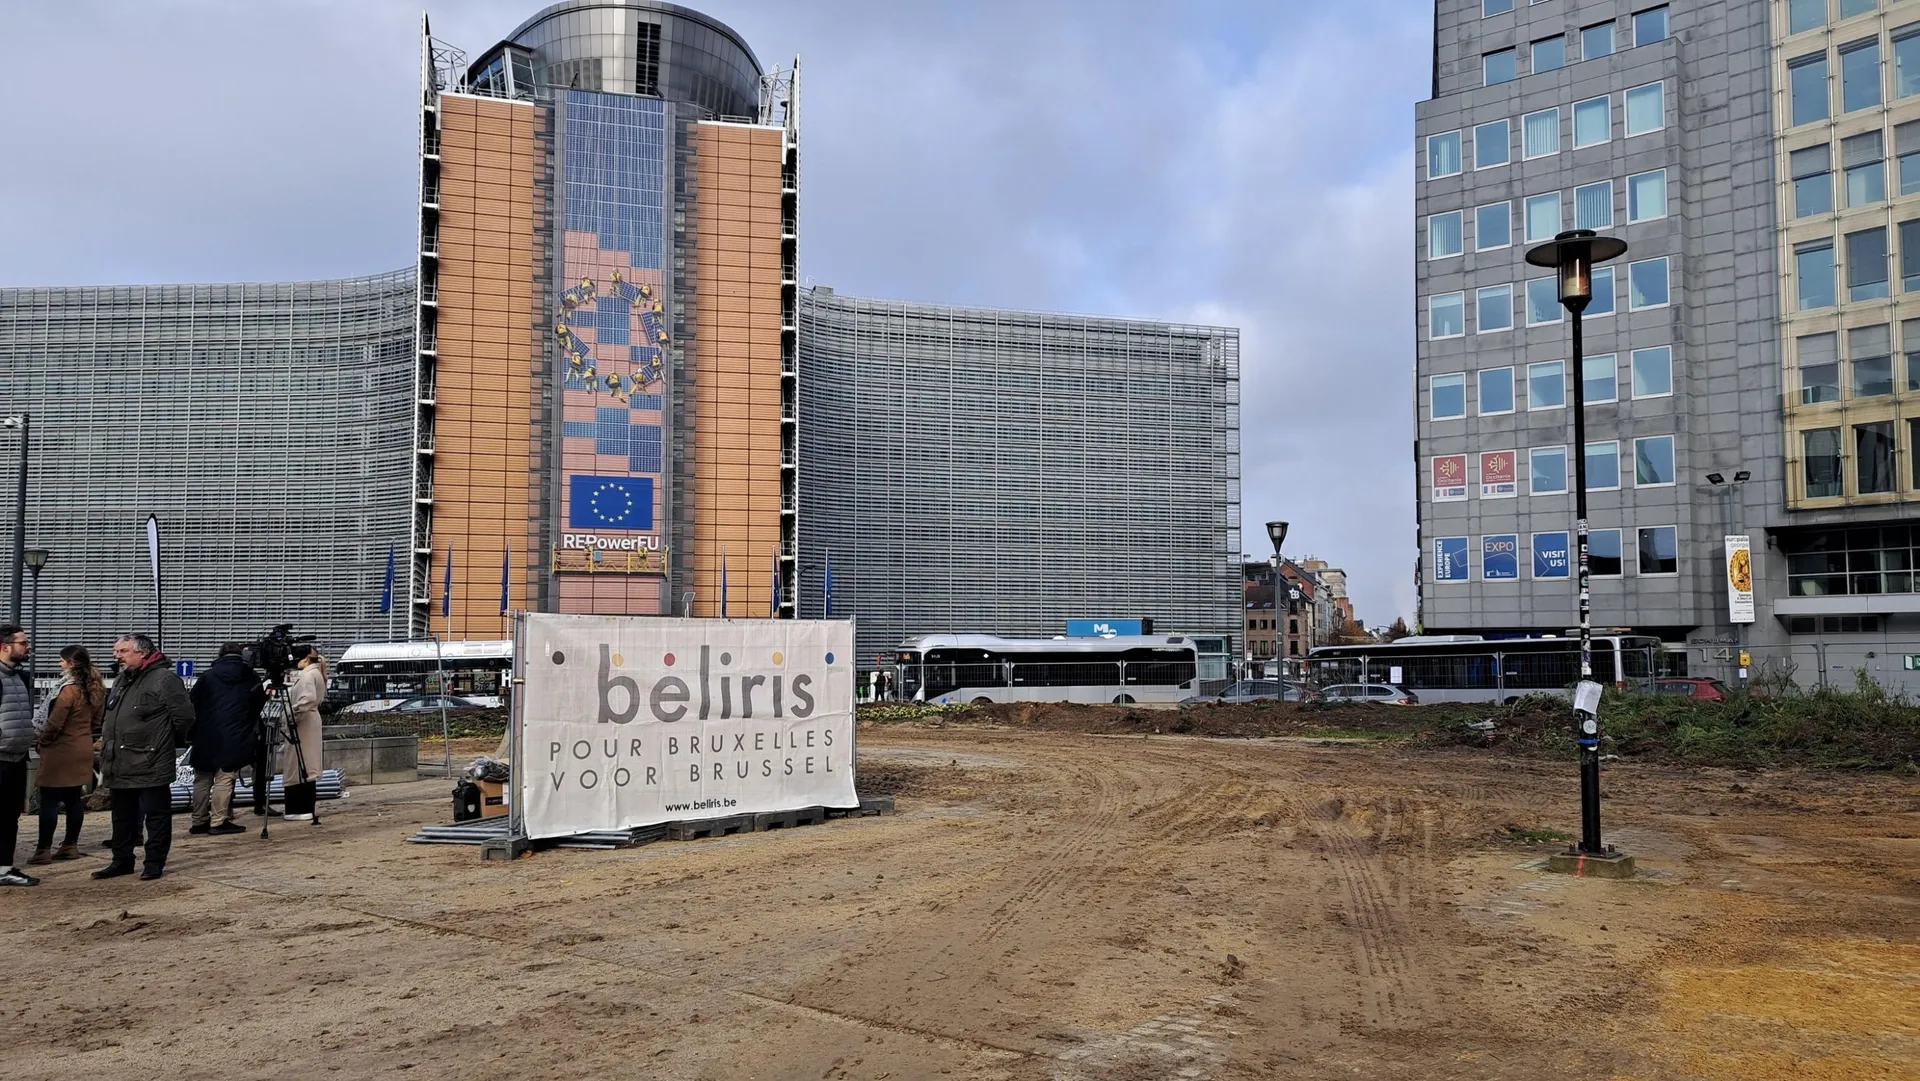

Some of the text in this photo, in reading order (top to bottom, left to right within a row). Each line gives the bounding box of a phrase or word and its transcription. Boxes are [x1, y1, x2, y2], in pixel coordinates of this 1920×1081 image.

[563, 534, 659, 550] REPowerEU
[1485, 541, 1514, 553] EXPO
[1541, 550, 1566, 559] VISIT
[1550, 559, 1566, 567] US!
[1700, 647, 1734, 663] 14
[598, 643, 815, 724] beliris
[550, 729, 834, 762] POUR BRUXELLES
[550, 755, 833, 792] VOOR BRUSSEL
[665, 797, 737, 812] www.beliris.be
